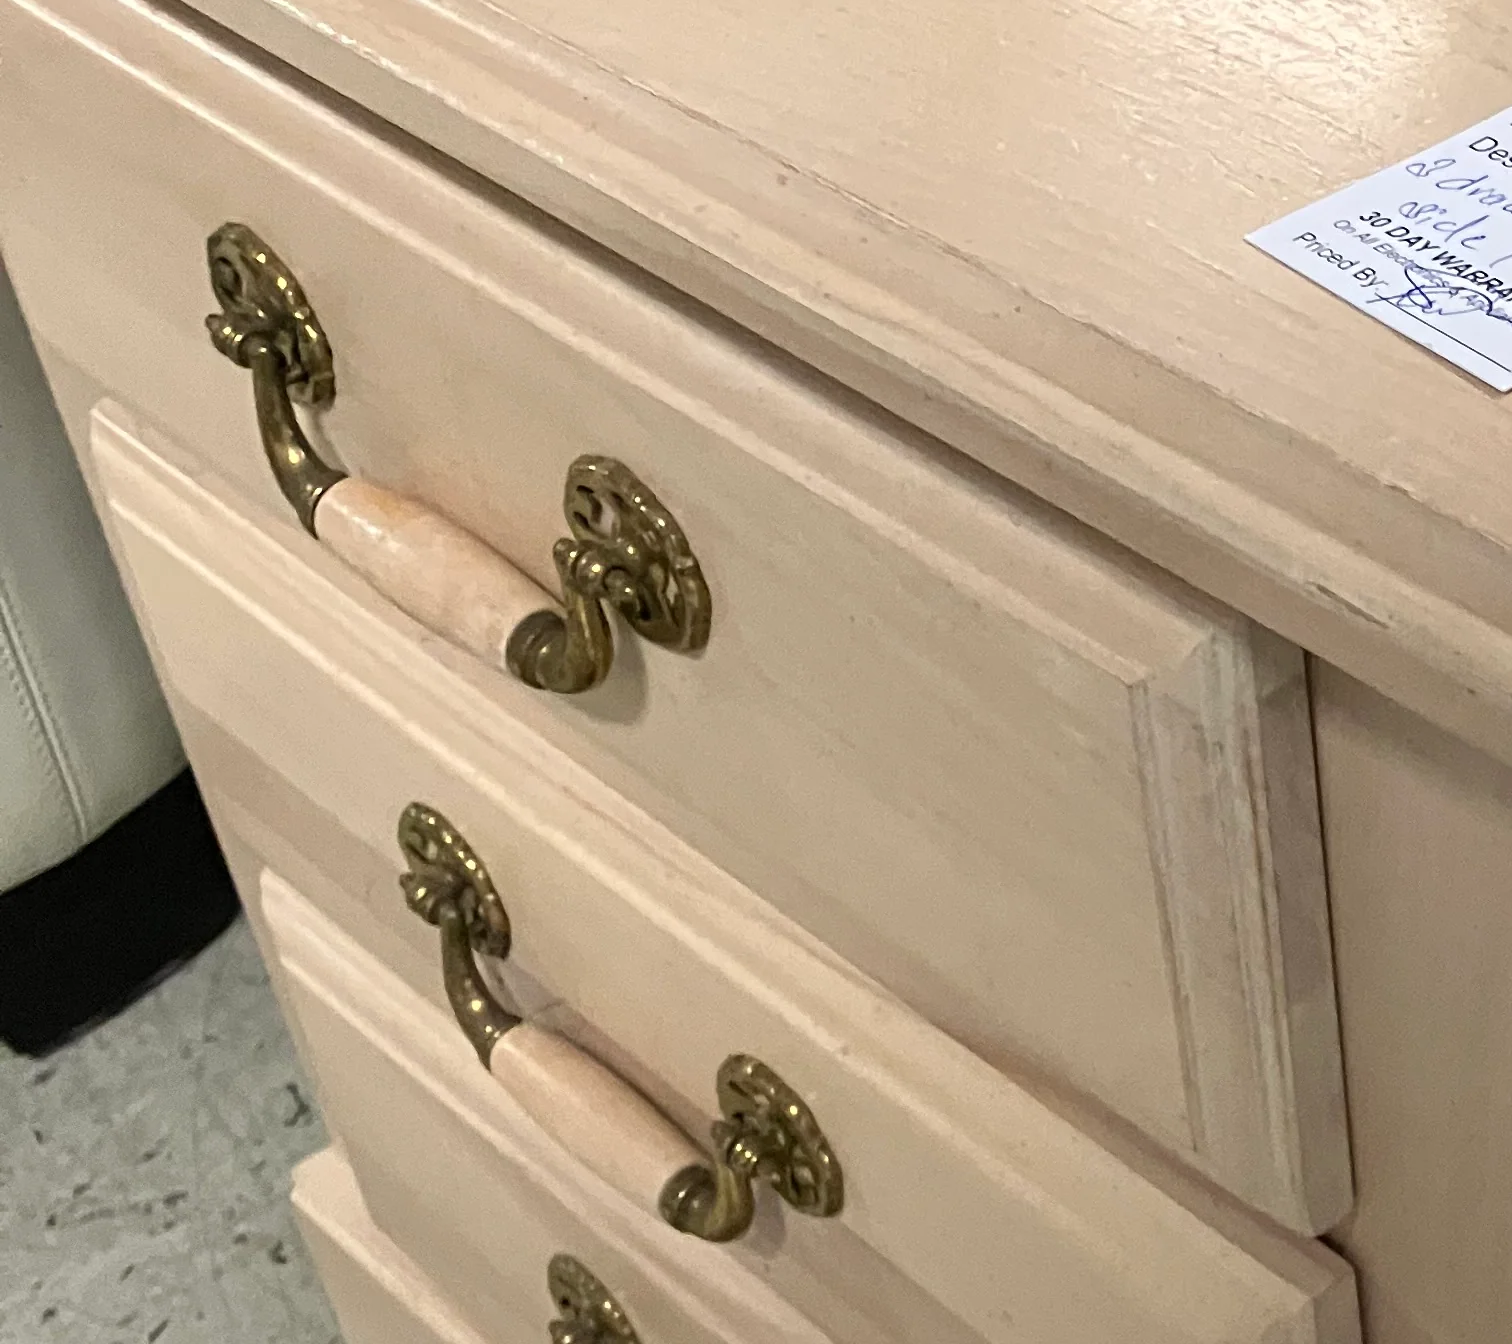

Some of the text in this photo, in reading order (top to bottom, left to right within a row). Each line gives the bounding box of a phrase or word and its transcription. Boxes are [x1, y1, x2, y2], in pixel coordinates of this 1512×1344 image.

[1332, 219, 1357, 234] On
[1353, 232, 1381, 246] All
[1358, 210, 1393, 228] 30
[1383, 225, 1442, 253] DAY
[1291, 231, 1390, 291] Priced By:
